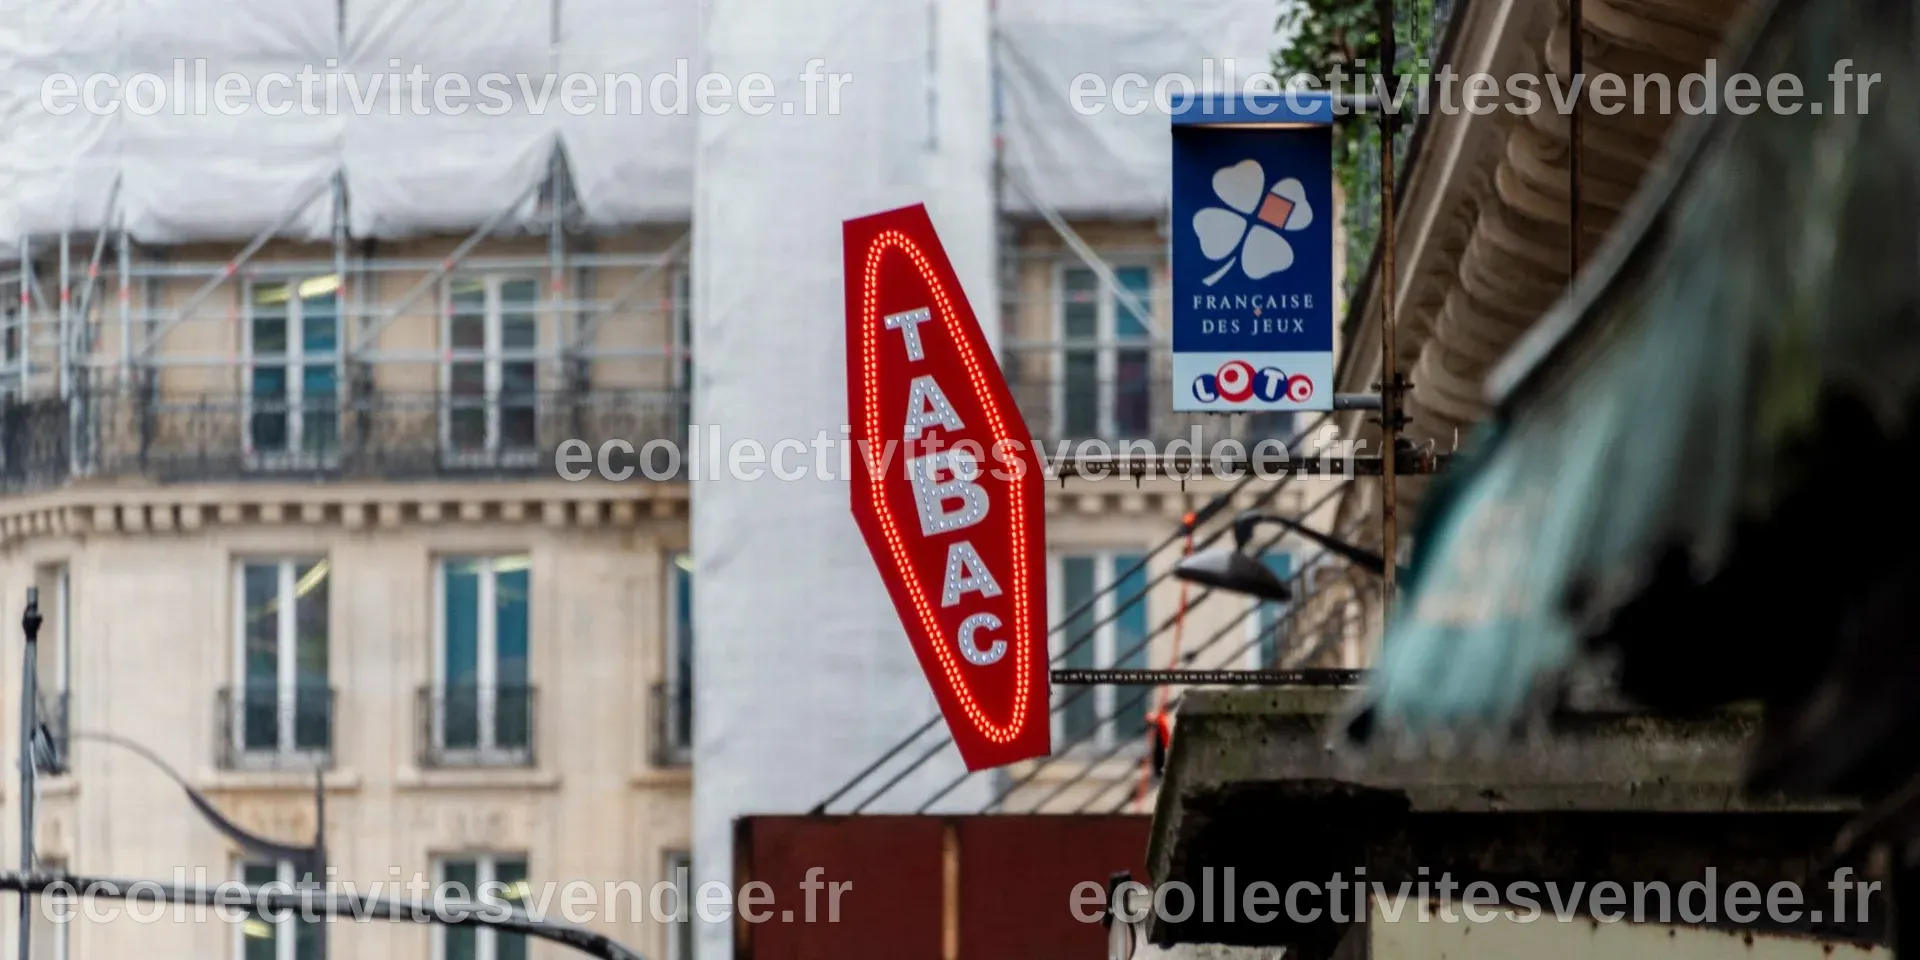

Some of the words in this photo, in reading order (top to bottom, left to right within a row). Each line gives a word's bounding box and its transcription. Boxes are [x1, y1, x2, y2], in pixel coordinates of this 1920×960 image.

[1193, 293, 1314, 312] FRANÇAISE
[1202, 319, 1241, 335] DES
[1251, 318, 1305, 336] JEUX
[1193, 362, 1313, 402] LOTO
[884, 306, 1007, 666] TABAC
